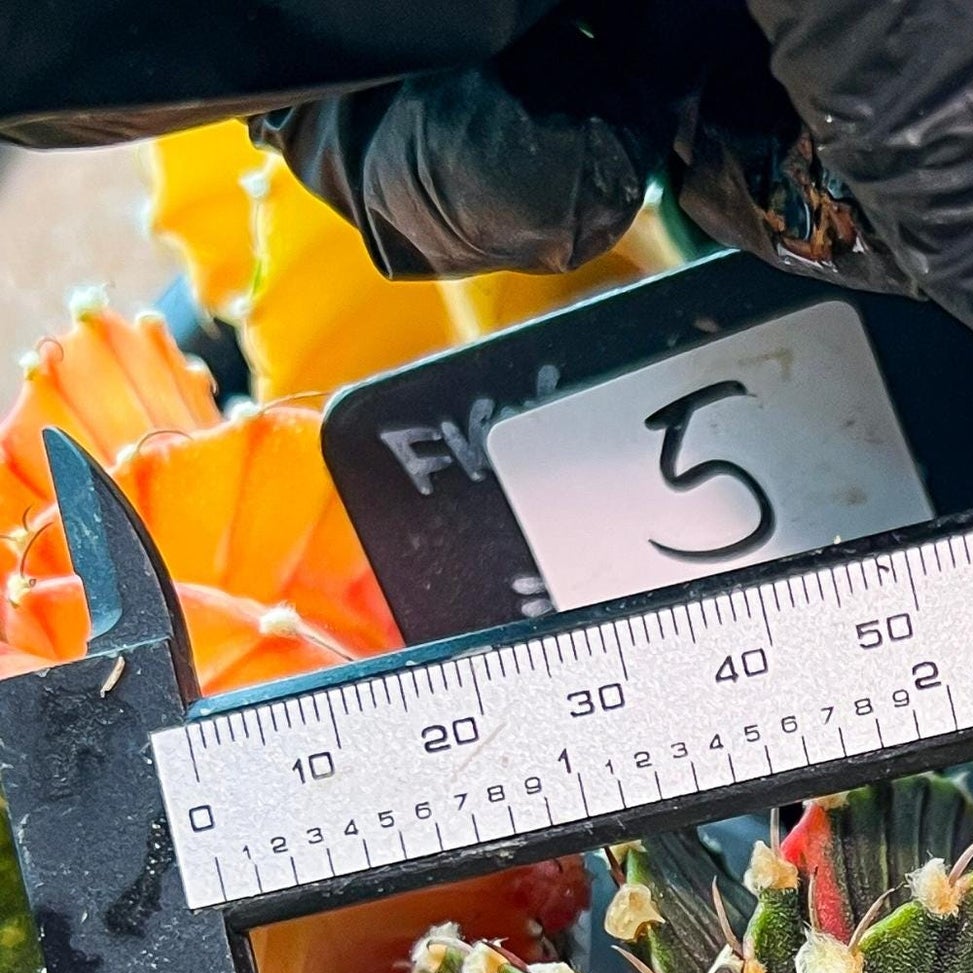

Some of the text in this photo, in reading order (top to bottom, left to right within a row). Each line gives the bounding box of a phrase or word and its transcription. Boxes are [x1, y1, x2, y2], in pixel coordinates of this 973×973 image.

[644, 379, 776, 563] 5
[188, 804, 215, 833] 0
[291, 750, 335, 784] 10
[420, 716, 479, 754] 20
[566, 682, 626, 718] 30
[715, 648, 768, 683] 40
[855, 612, 914, 650] 50
[241, 843, 252, 860] 1
[270, 836, 288, 854] 2
[306, 827, 324, 845] 3
[343, 819, 359, 836] 4
[377, 810, 395, 829] 5
[414, 801, 432, 820] 6
[454, 792, 468, 810] 7
[486, 784, 506, 803] 8
[524, 776, 543, 796] 9
[557, 748, 573, 775] 1
[604, 759, 614, 775] 1
[633, 751, 652, 769] 2
[670, 741, 689, 759] 3
[709, 733, 724, 751] 4
[743, 724, 761, 743] 5
[780, 715, 798, 734] 6
[820, 706, 834, 725] 7
[853, 697, 874, 716] 8
[892, 689, 910, 709] 9
[911, 661, 942, 690] 2
